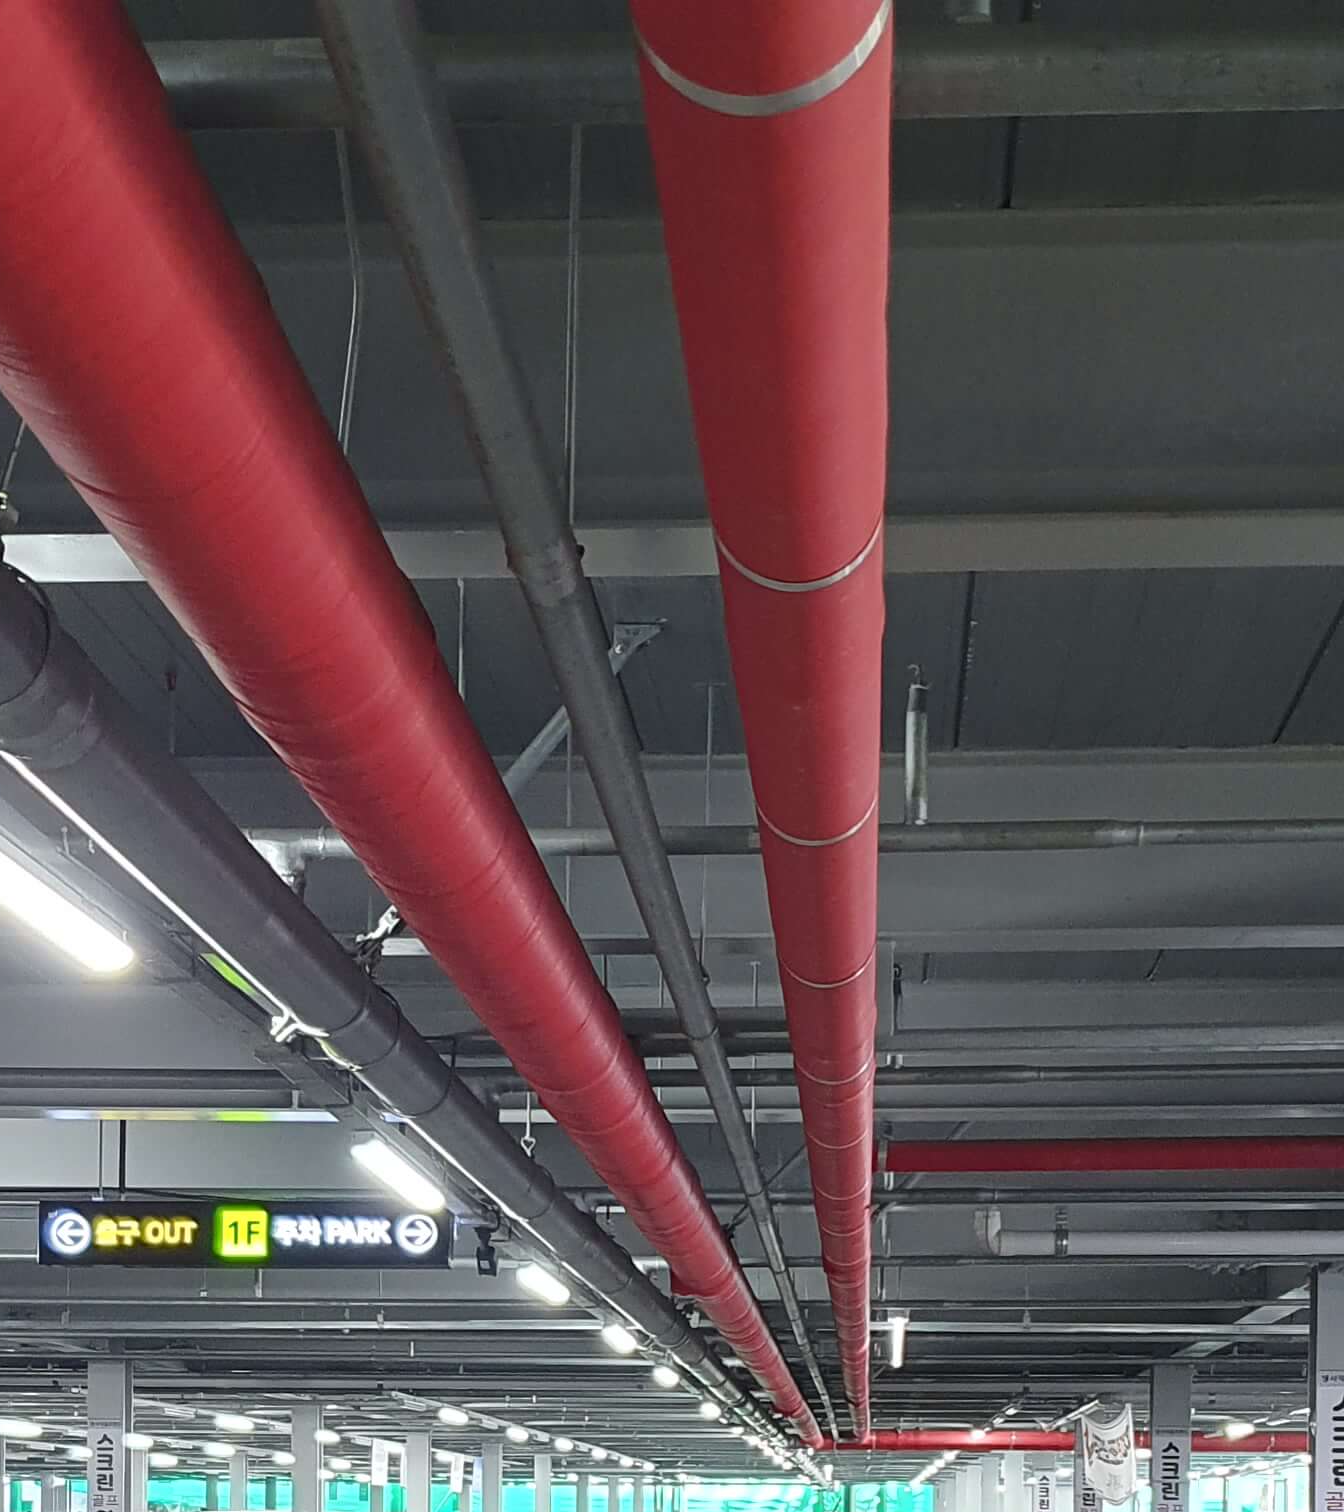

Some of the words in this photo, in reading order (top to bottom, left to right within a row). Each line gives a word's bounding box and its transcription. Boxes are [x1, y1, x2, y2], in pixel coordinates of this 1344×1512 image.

[144, 1217, 197, 1245] OUT
[228, 1219, 260, 1246] 1F
[325, 1216, 392, 1245] PARK
[96, 1433, 114, 1492] 스크린
[1161, 1441, 1180, 1501] 스크린
